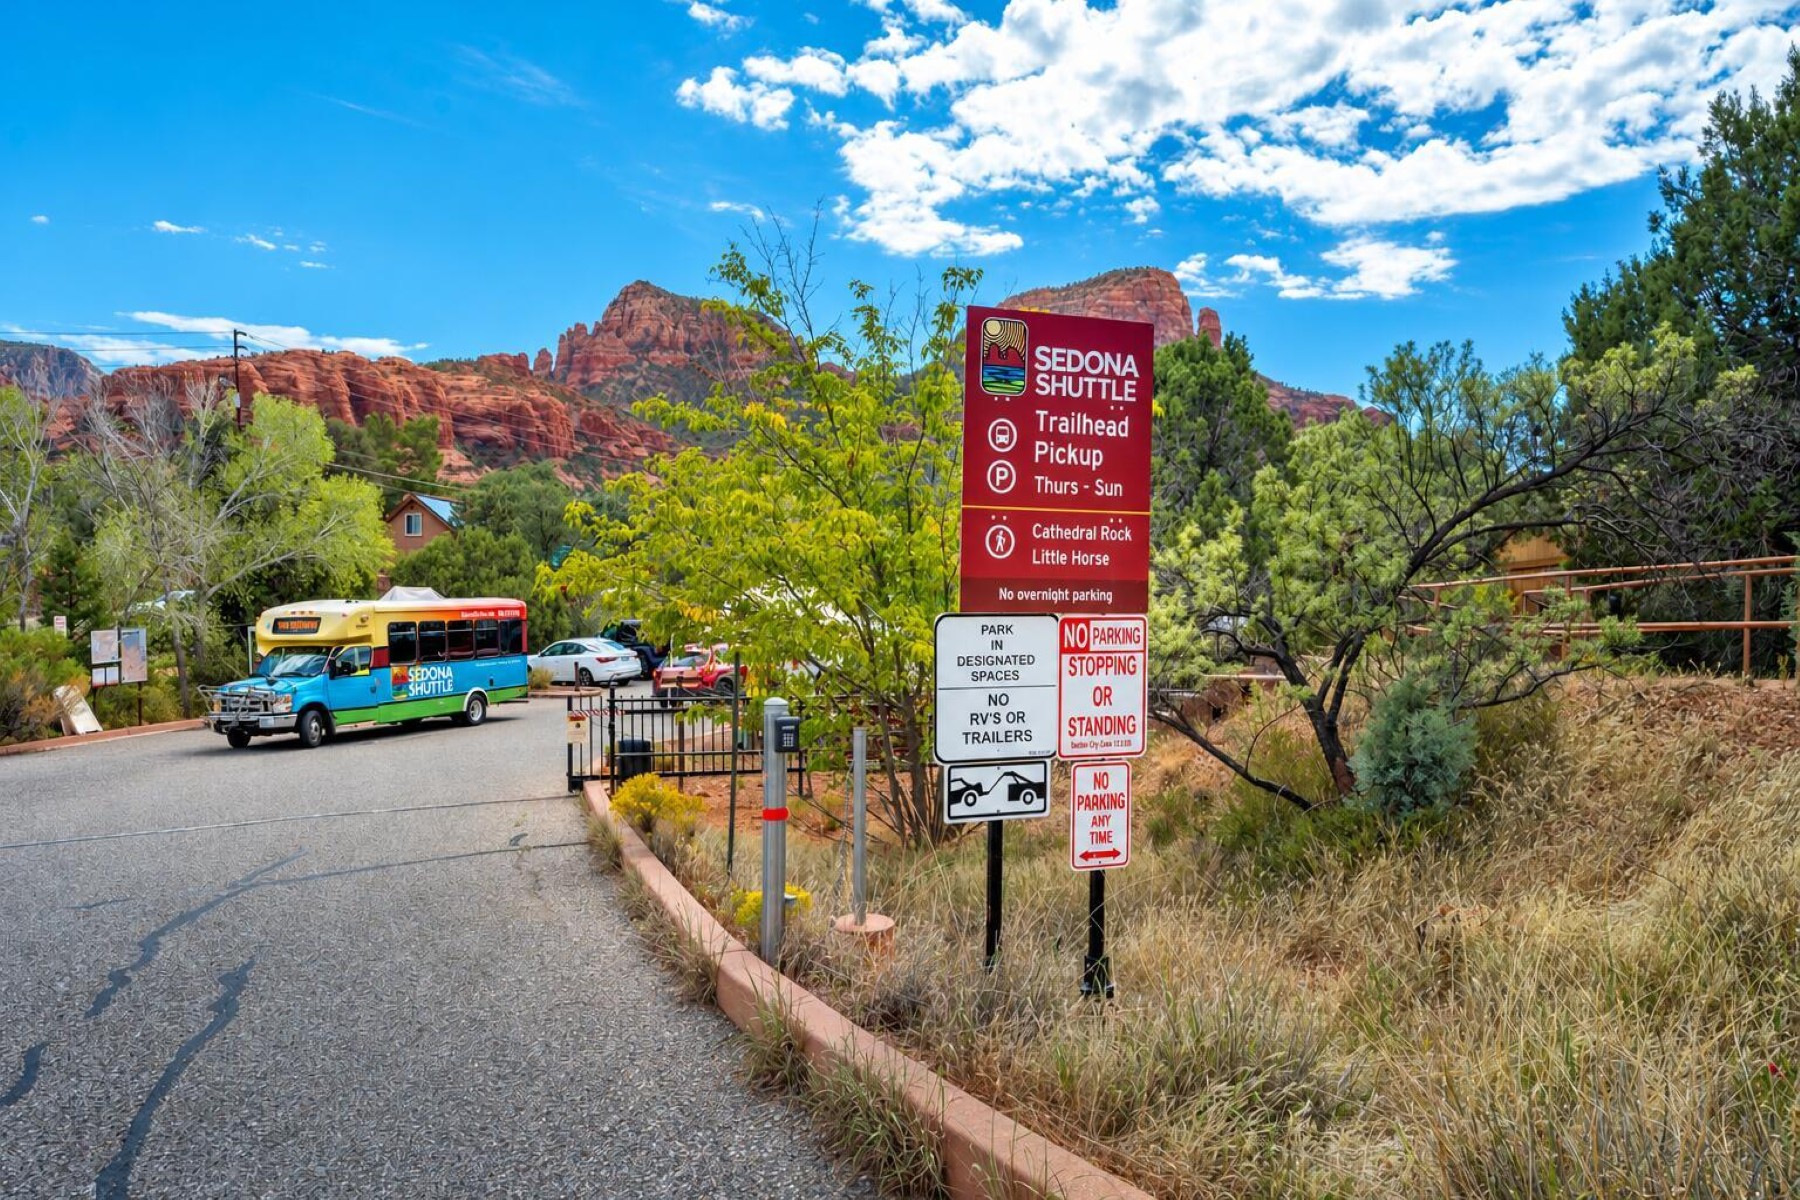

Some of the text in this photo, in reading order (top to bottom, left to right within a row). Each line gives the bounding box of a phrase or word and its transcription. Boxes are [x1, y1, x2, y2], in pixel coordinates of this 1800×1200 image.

[1034, 346, 1140, 378] SEDONA
[1035, 373, 1137, 402] SHUTTLE
[1035, 410, 1129, 437] Trailhead
[1034, 441, 1104, 471] Pickup
[994, 467, 1009, 487] P
[1034, 476, 1079, 494] Thurs
[1094, 480, 1123, 497] Sun
[1032, 523, 1132, 541] Cathedral Rock
[1032, 549, 1110, 566] Little Horse
[998, 587, 1113, 605] No overnight parking
[981, 624, 1014, 636] PARK
[1063, 622, 1141, 649] NO PARKING
[991, 640, 1003, 651] IN
[957, 654, 1036, 667] DESIGNATED
[1068, 655, 1137, 677] STOPPING
[408, 666, 453, 682] SEDONA
[971, 670, 1020, 682] SPACES
[408, 679, 454, 697] SHUTTLE
[1092, 685, 1113, 707] OR
[988, 693, 1010, 707] NO
[969, 710, 1026, 726] RV'S OR
[1068, 715, 1137, 737] STANDING
[962, 729, 1033, 745] TRAILERS
[1093, 771, 1109, 790] NO
[1077, 792, 1126, 811] PARKING
[1090, 814, 1112, 828] ANY
[1089, 830, 1113, 845] TIME
